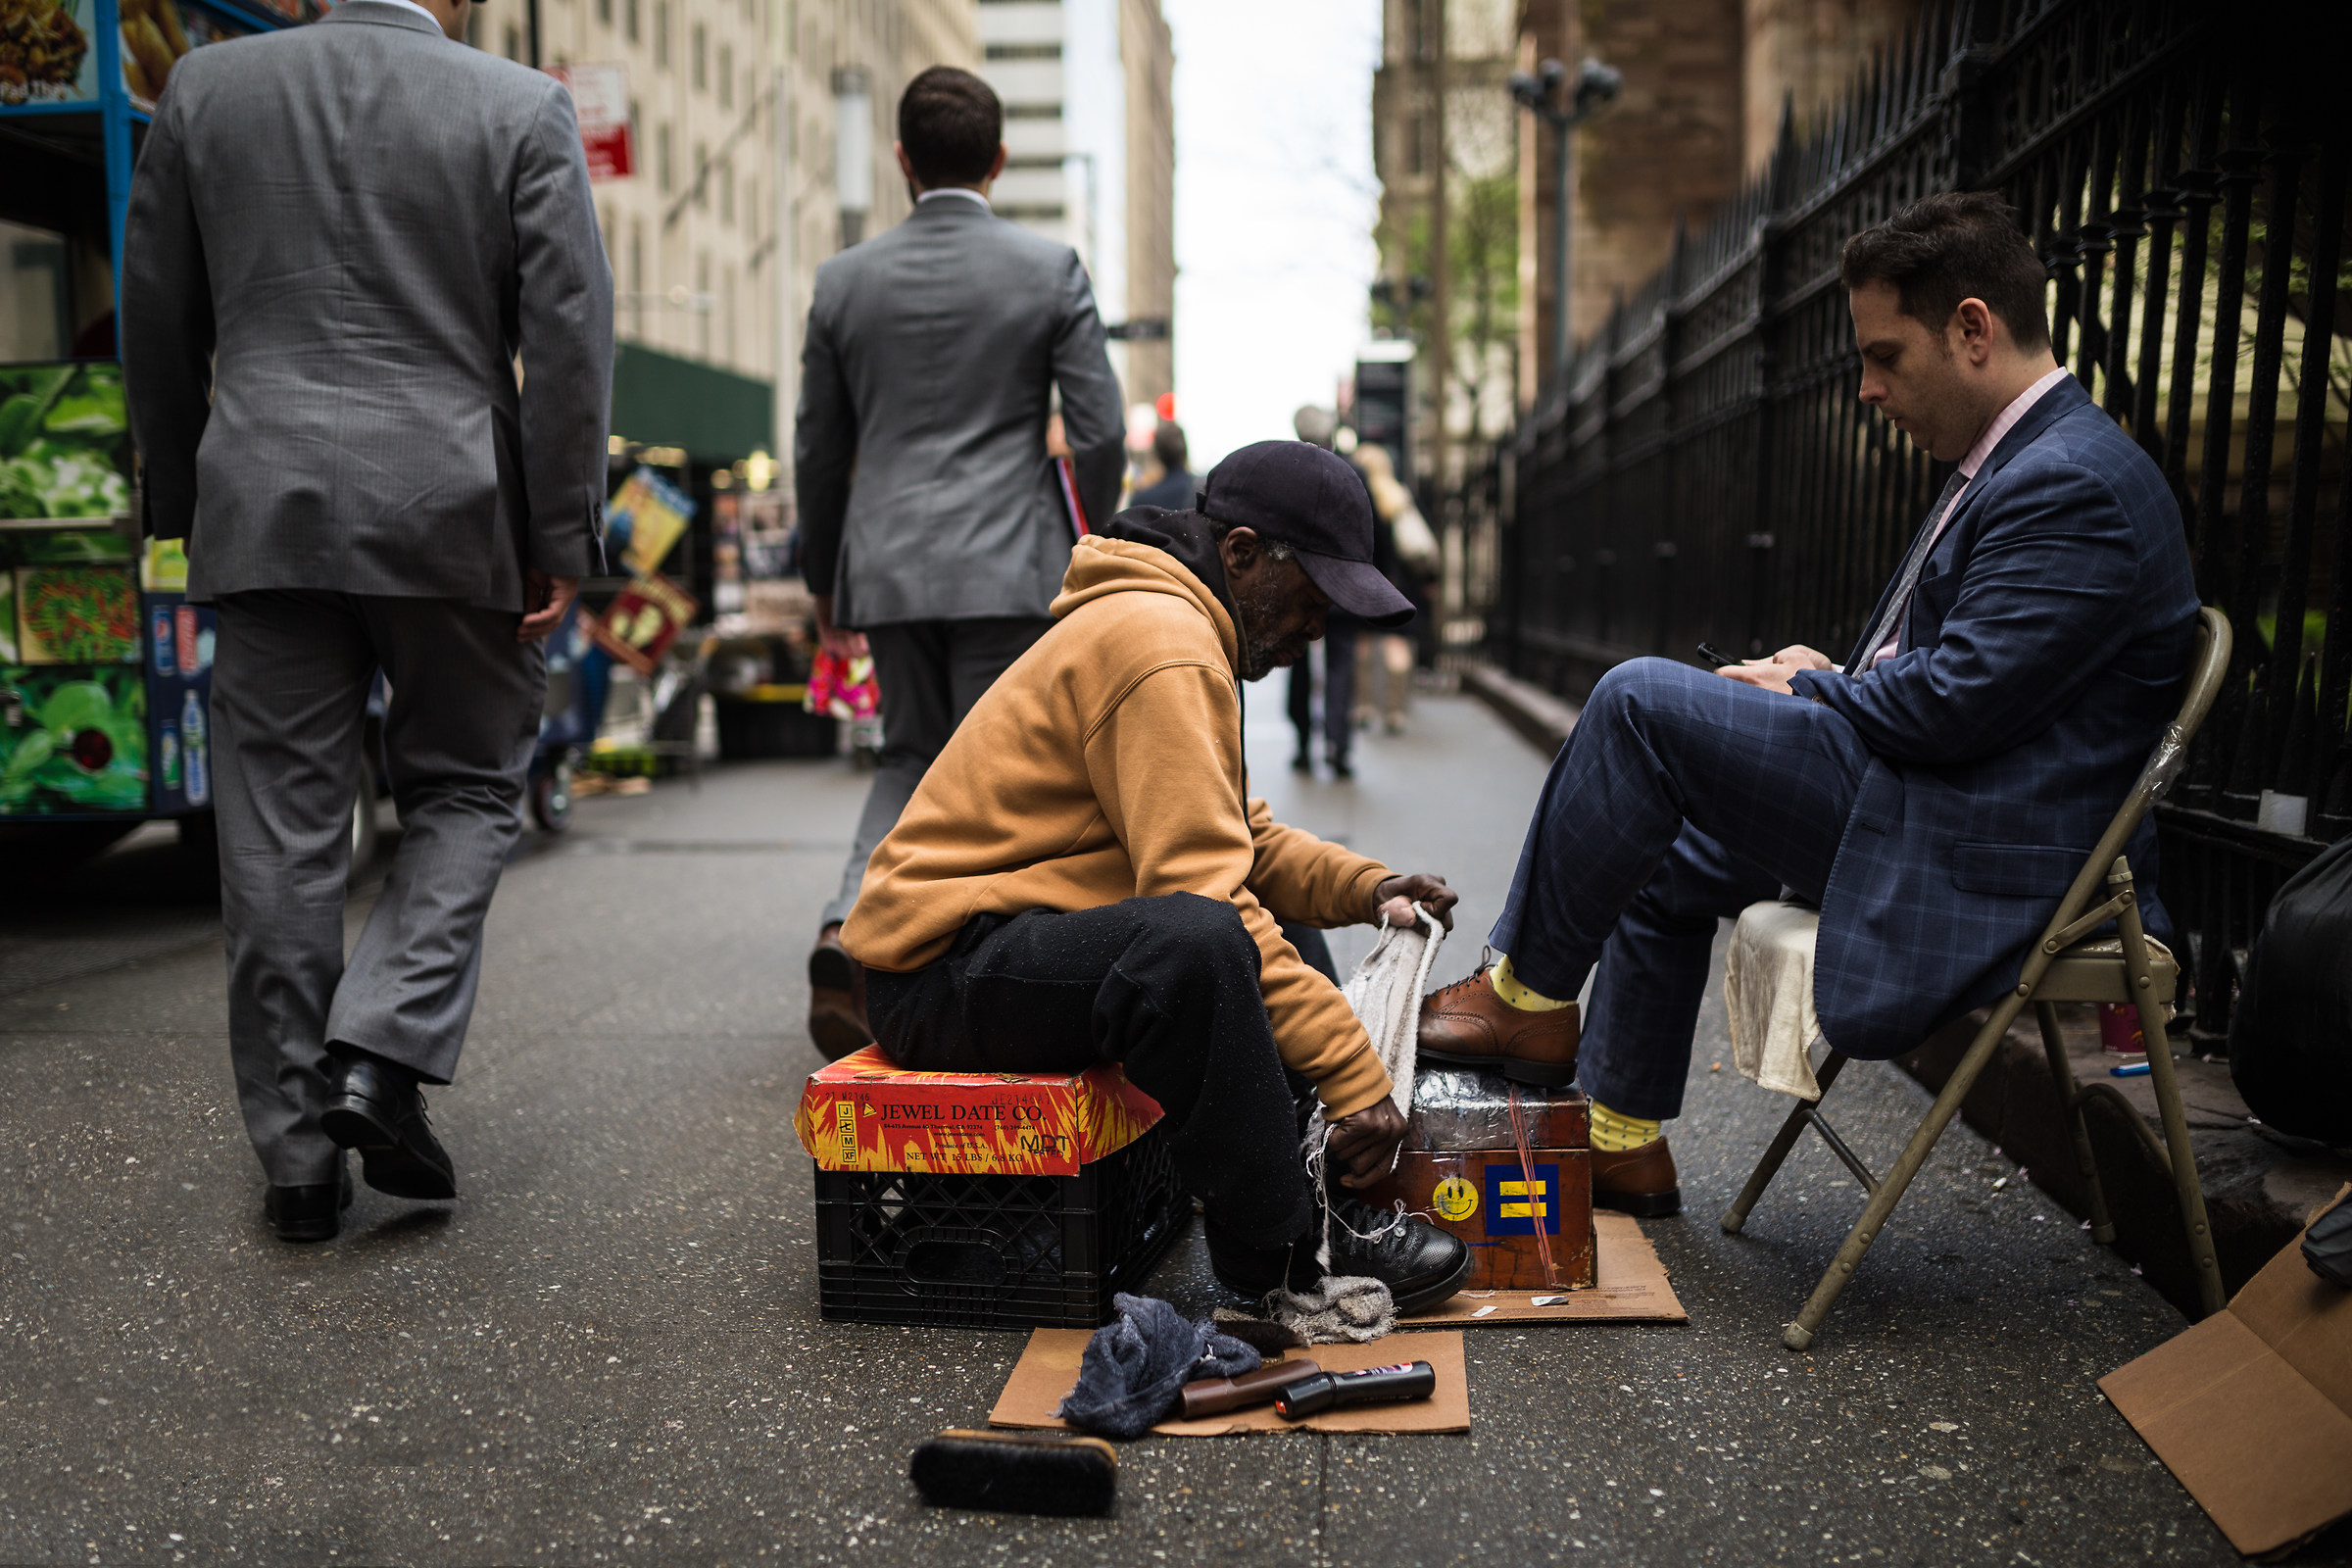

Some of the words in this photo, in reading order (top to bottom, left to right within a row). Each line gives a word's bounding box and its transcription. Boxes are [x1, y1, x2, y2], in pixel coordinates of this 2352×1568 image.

[843, 1106, 849, 1115] J
[880, 1103, 946, 1121] JEWEL
[951, 1104, 1006, 1121] DATE
[1011, 1104, 1047, 1122] CO.
[1020, 1133, 1069, 1152] MDT
[845, 1152, 855, 1160] XF
[906, 1152, 927, 1160] NET
[929, 1152, 947, 1161] WT
[964, 1152, 983, 1162] LBS
[991, 1153, 1005, 1162] 6.8
[1007, 1153, 1023, 1162] KG
